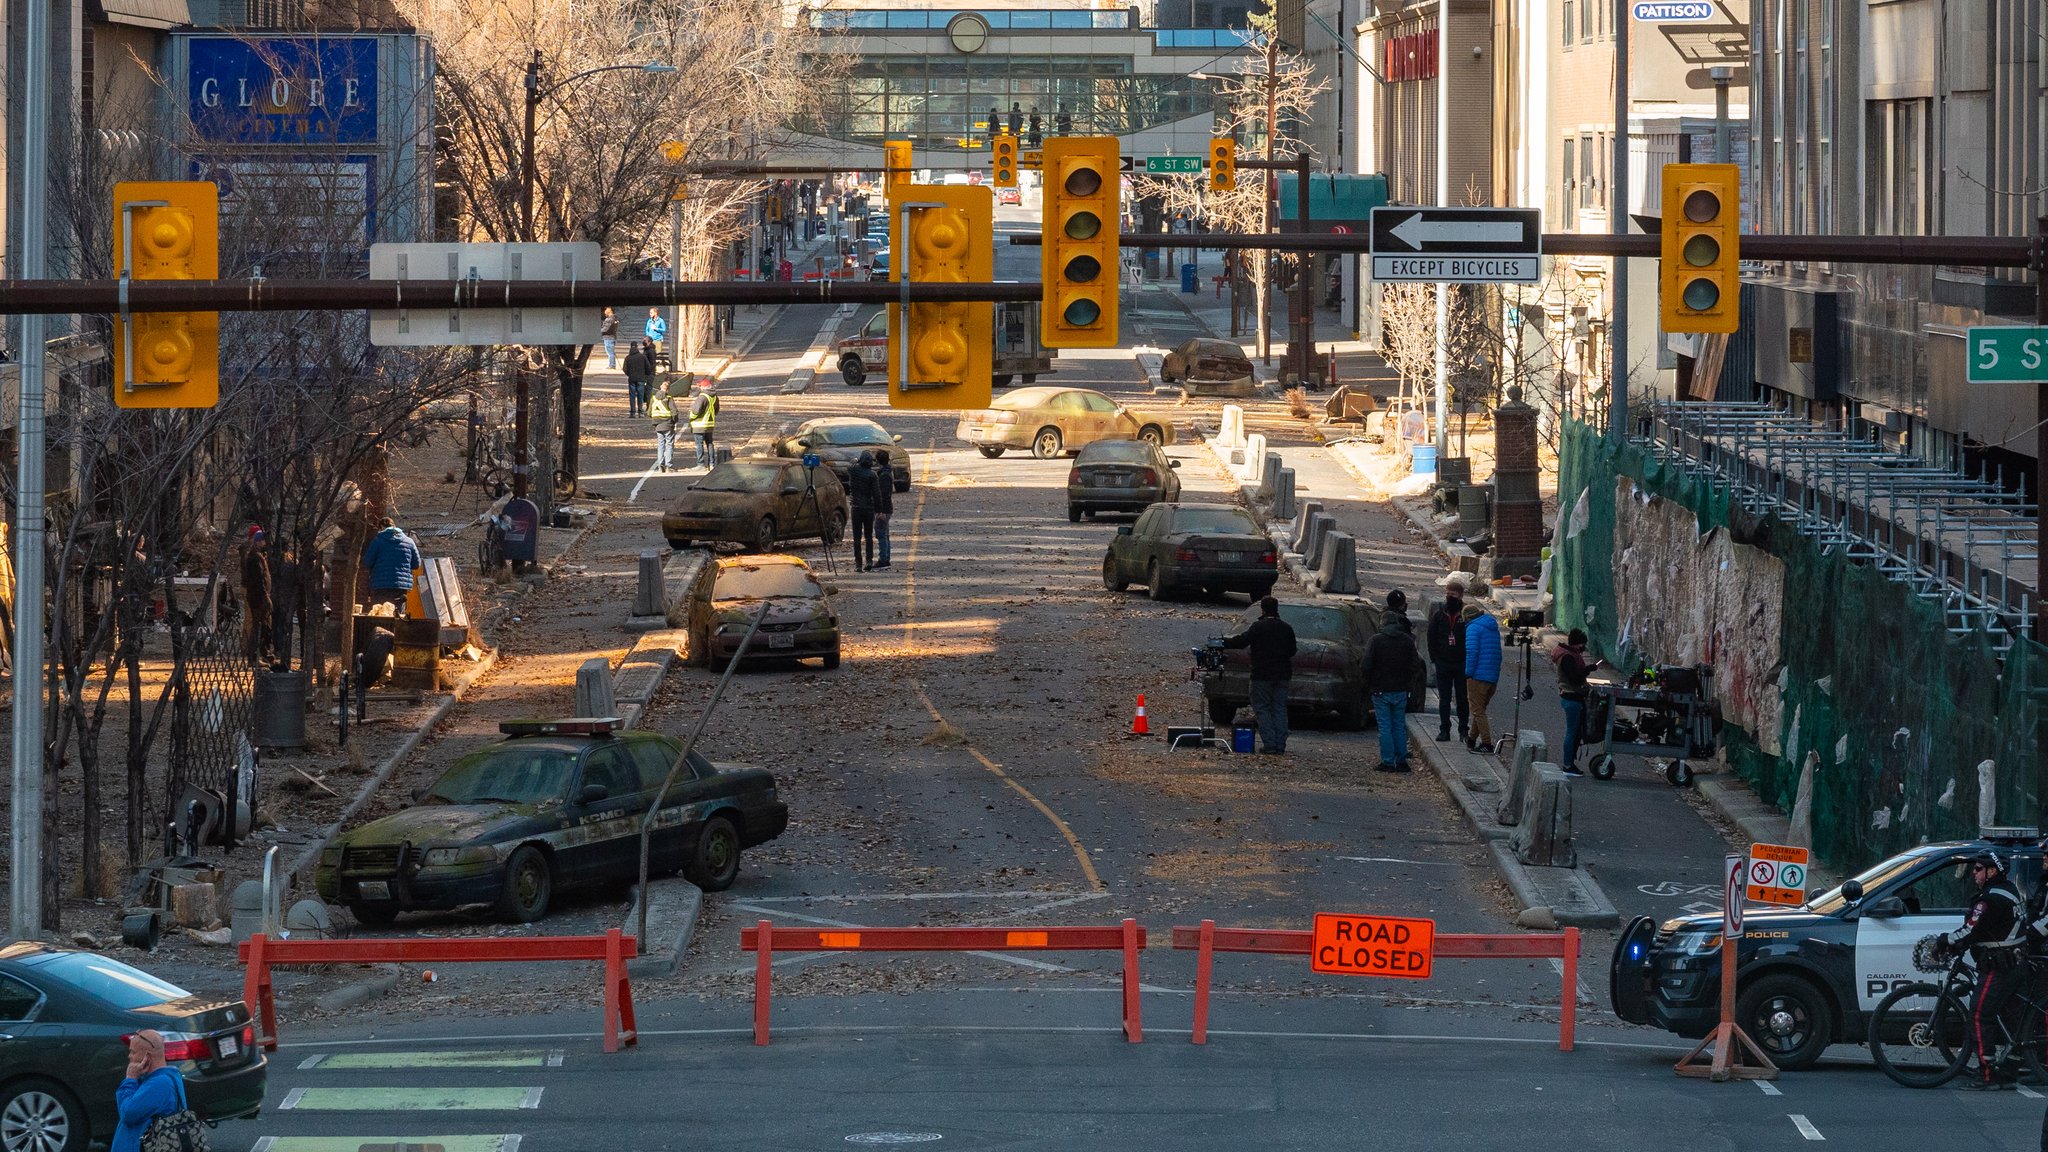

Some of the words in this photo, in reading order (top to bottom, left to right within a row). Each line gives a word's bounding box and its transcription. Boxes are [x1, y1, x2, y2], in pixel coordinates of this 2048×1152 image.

[1638, 4, 1707, 18] PATTISON
[201, 77, 360, 108] GLOBE
[238, 118, 325, 134] CINEMA
[1149, 160, 1156, 169] 6
[1164, 160, 1177, 169] ST
[1183, 160, 1199, 169] SW
[1392, 260, 1445, 275] EXCEPT
[1452, 261, 1519, 276] BICYCLES
[1978, 339, 1999, 369] 5
[2020, 338, 2048, 370] S
[579, 808, 625, 825] KCMO
[1760, 845, 1801, 855] PEDESTRIAN
[1990, 852, 2005, 872] POLICE
[1336, 921, 1411, 944] ROAD
[1745, 931, 1790, 939] POLICE
[1319, 945, 1424, 971] CLOSED
